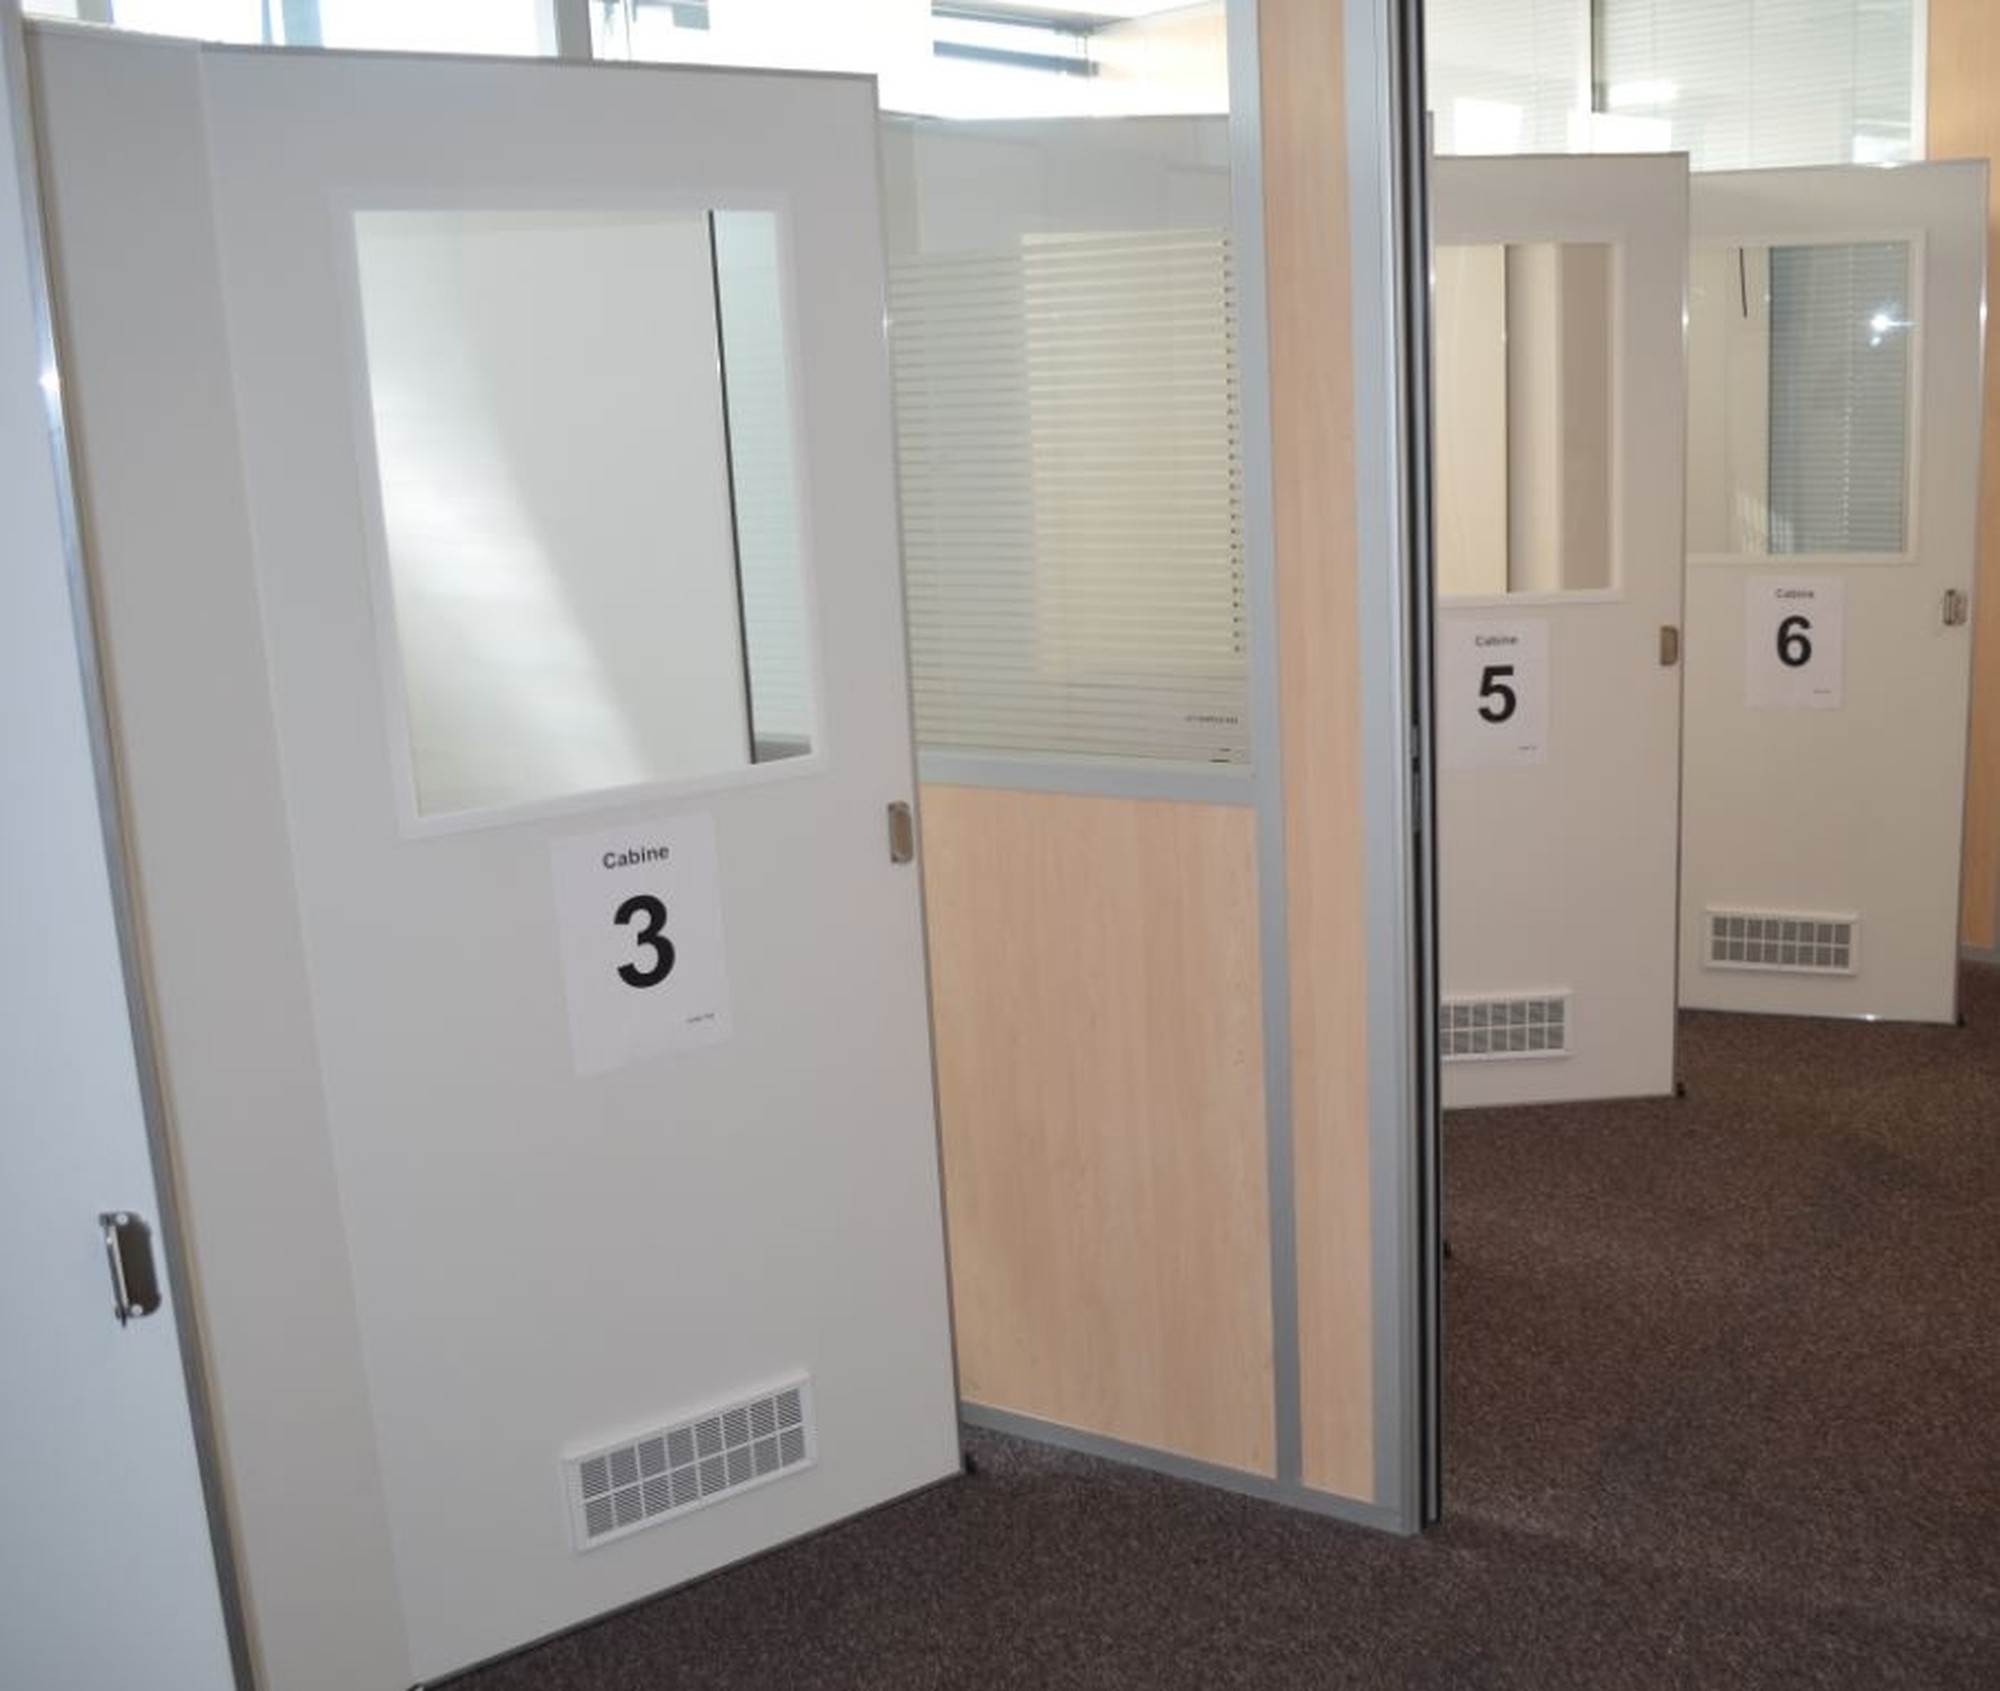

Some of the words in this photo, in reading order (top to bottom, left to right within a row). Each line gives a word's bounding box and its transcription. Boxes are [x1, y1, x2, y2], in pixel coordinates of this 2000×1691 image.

[1775, 588, 1815, 600] Cabine
[1474, 634, 1519, 648] Cabine
[1776, 615, 1813, 668] 6
[1477, 664, 1517, 724] 5
[602, 845, 670, 870] Cabine
[613, 894, 676, 989] 3
